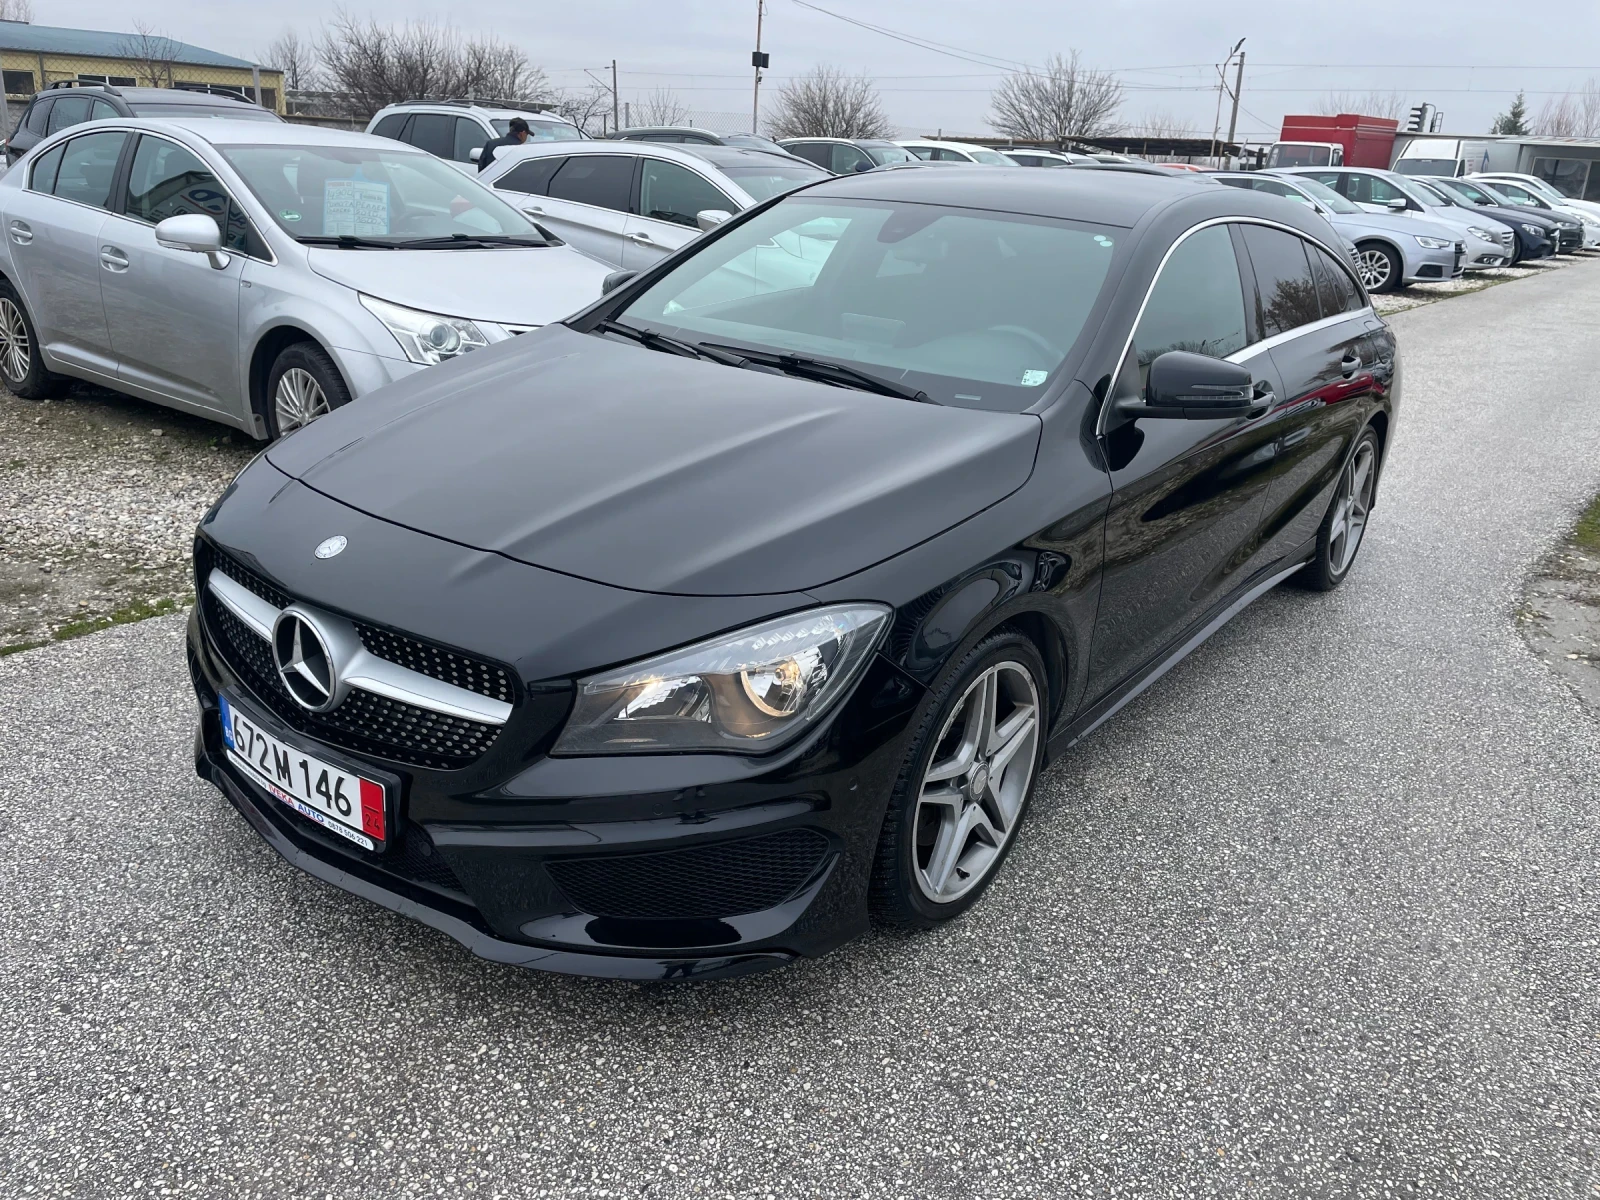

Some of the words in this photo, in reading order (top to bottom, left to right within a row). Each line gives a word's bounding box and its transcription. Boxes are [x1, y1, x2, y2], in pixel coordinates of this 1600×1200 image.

[233, 714, 293, 789] 672M
[299, 758, 352, 817] 146
[298, 803, 324, 823] AUTO
[364, 813, 380, 830] 24
